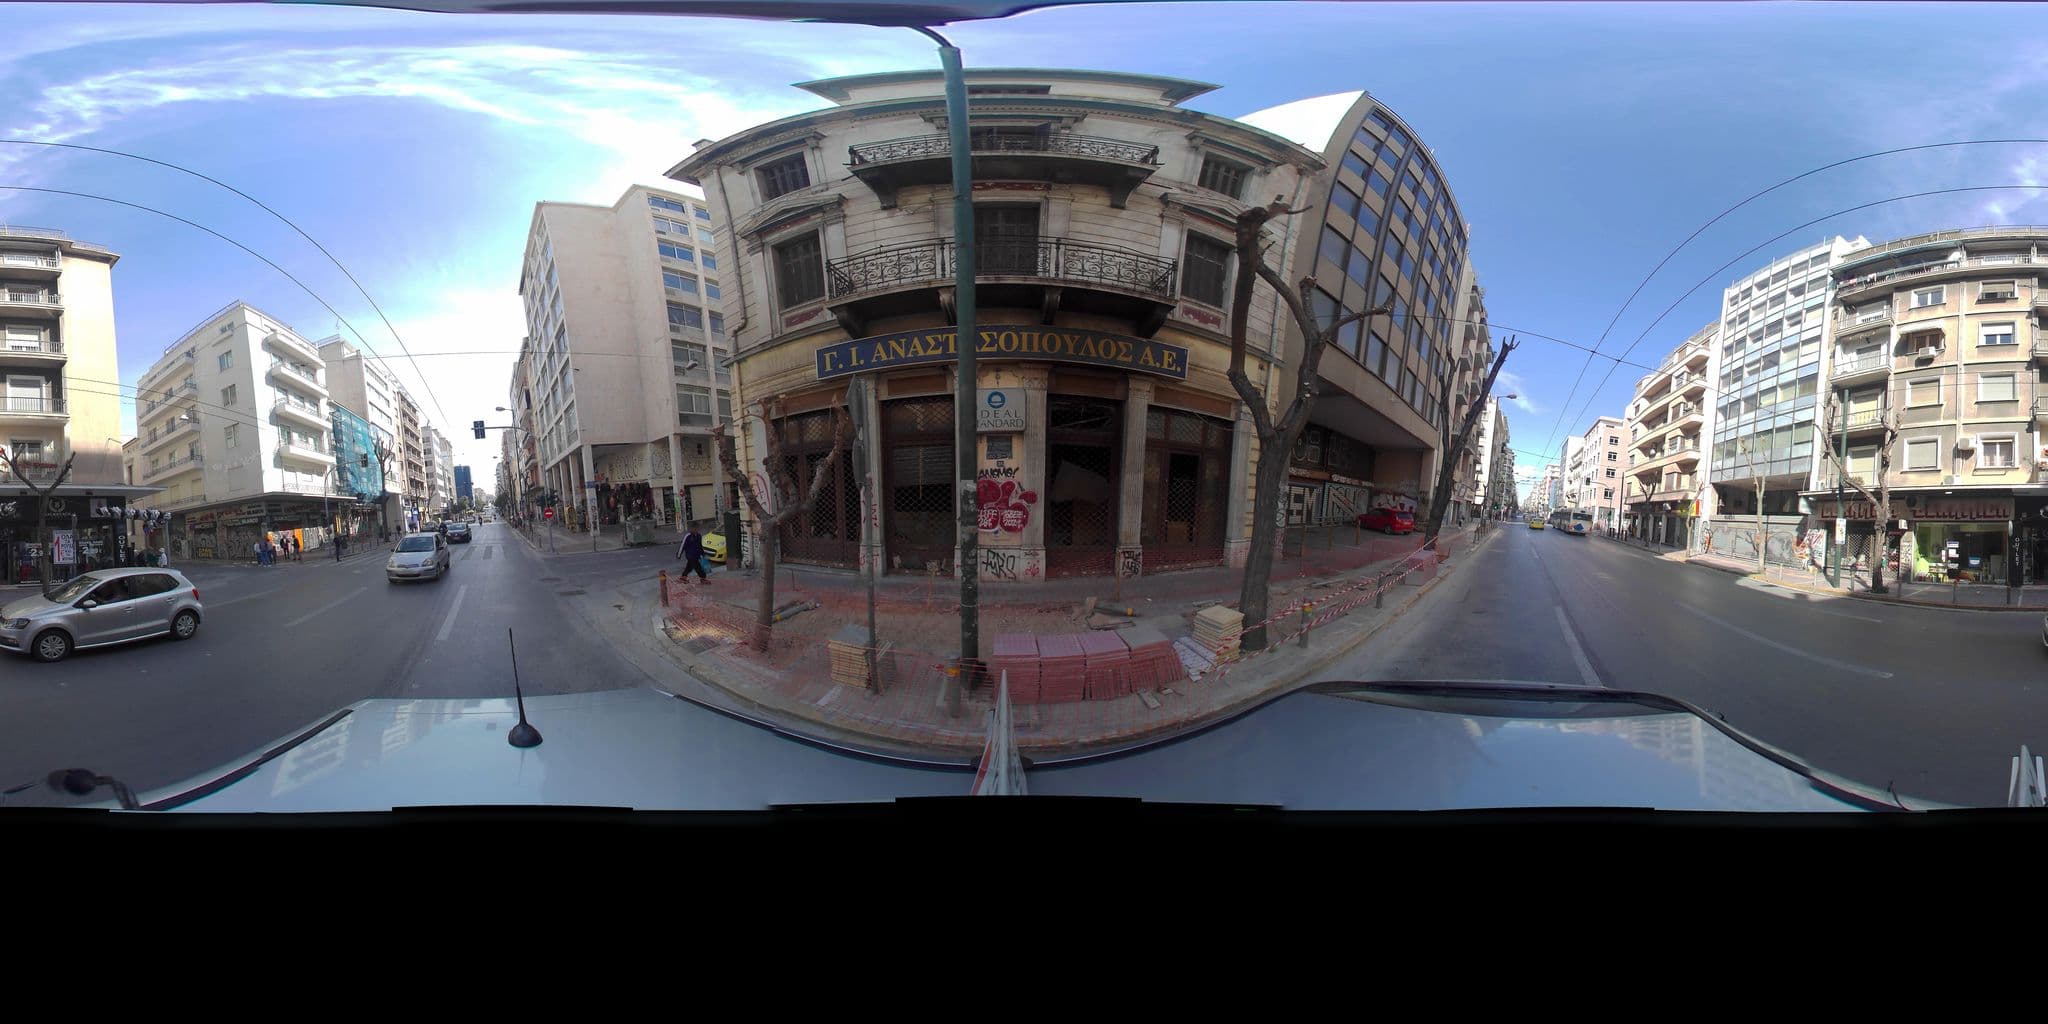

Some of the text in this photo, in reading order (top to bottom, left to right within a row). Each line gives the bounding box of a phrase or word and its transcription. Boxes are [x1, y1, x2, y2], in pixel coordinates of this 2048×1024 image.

[824, 352, 843, 371] Γ.
[1139, 345, 1182, 373] Α.Ε.
[118, 535, 126, 563] OUTLET
